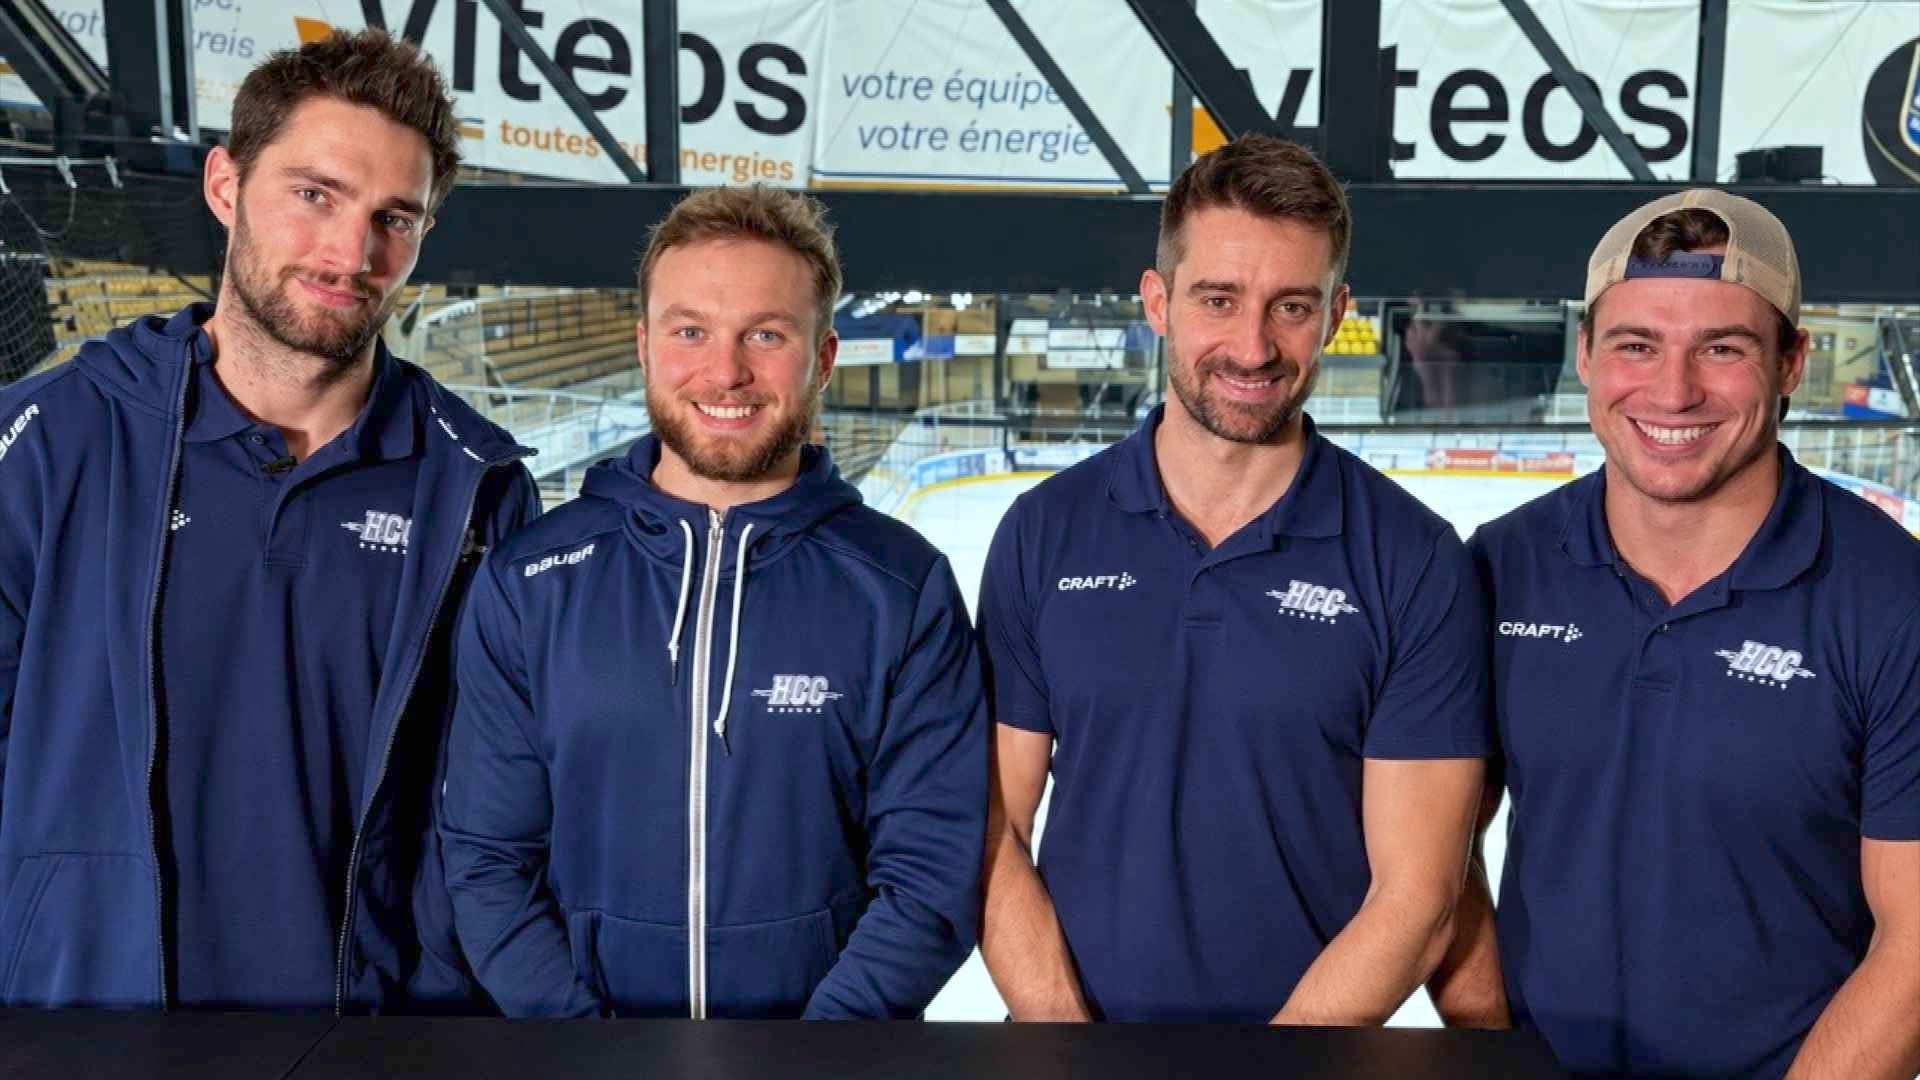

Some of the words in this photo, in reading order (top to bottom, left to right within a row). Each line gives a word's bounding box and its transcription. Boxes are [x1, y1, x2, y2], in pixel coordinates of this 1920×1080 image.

[842, 71, 934, 102] votre
[500, 120, 599, 158] toutes
[680, 147, 794, 182] nergies
[858, 121, 949, 151] votre
[959, 119, 1093, 162] énergie
[1058, 575, 1118, 591] CRAFT
[1280, 580, 1347, 617] HCC
[1499, 621, 1564, 639] CRAFT
[1728, 640, 1803, 681] HCC
[768, 673, 829, 706] HCC
